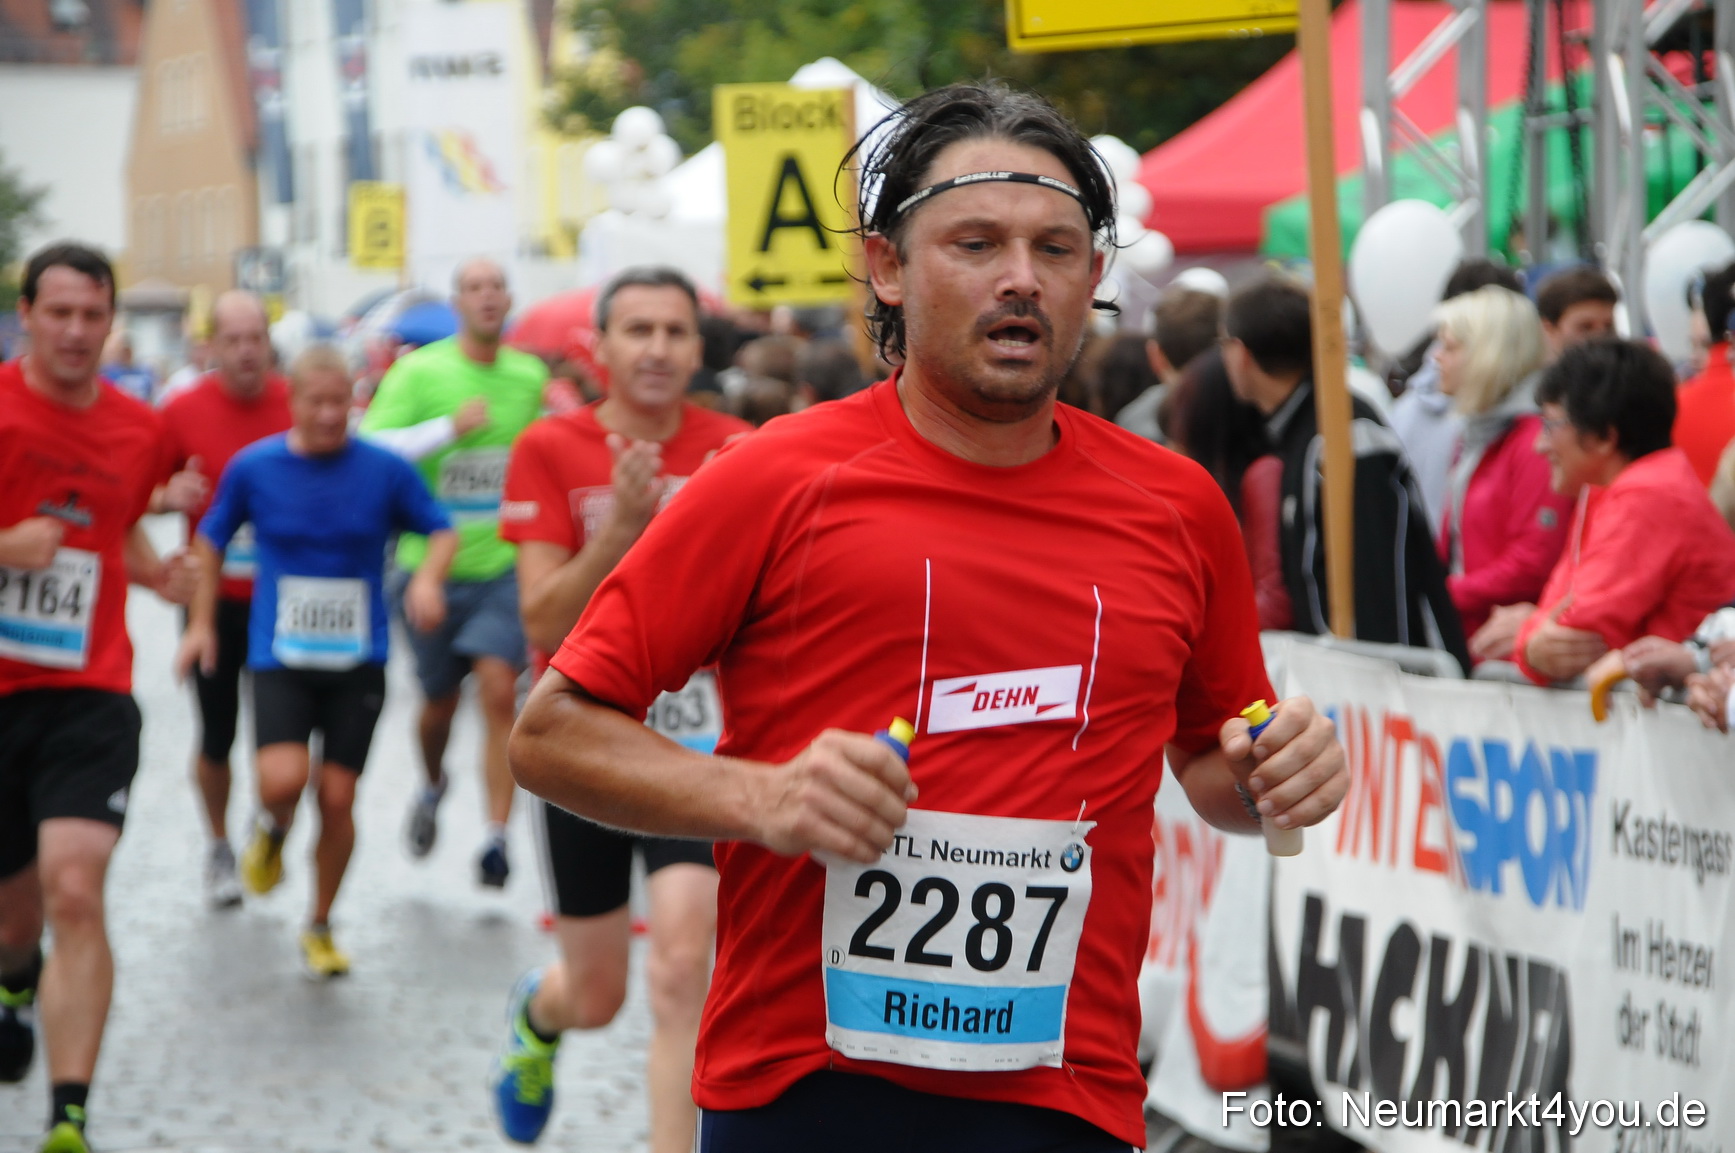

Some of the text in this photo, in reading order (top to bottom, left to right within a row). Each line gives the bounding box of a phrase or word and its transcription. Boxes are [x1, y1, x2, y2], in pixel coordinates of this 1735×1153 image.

[733, 95, 845, 131] Block
[760, 155, 830, 252] A
[972, 685, 1040, 712] DEHN
[882, 834, 1051, 868] TL Neumarkt
[848, 869, 1069, 973] 2287
[831, 949, 841, 964] D
[883, 990, 1014, 1034] Richard
[1617, 990, 1651, 1051] der
